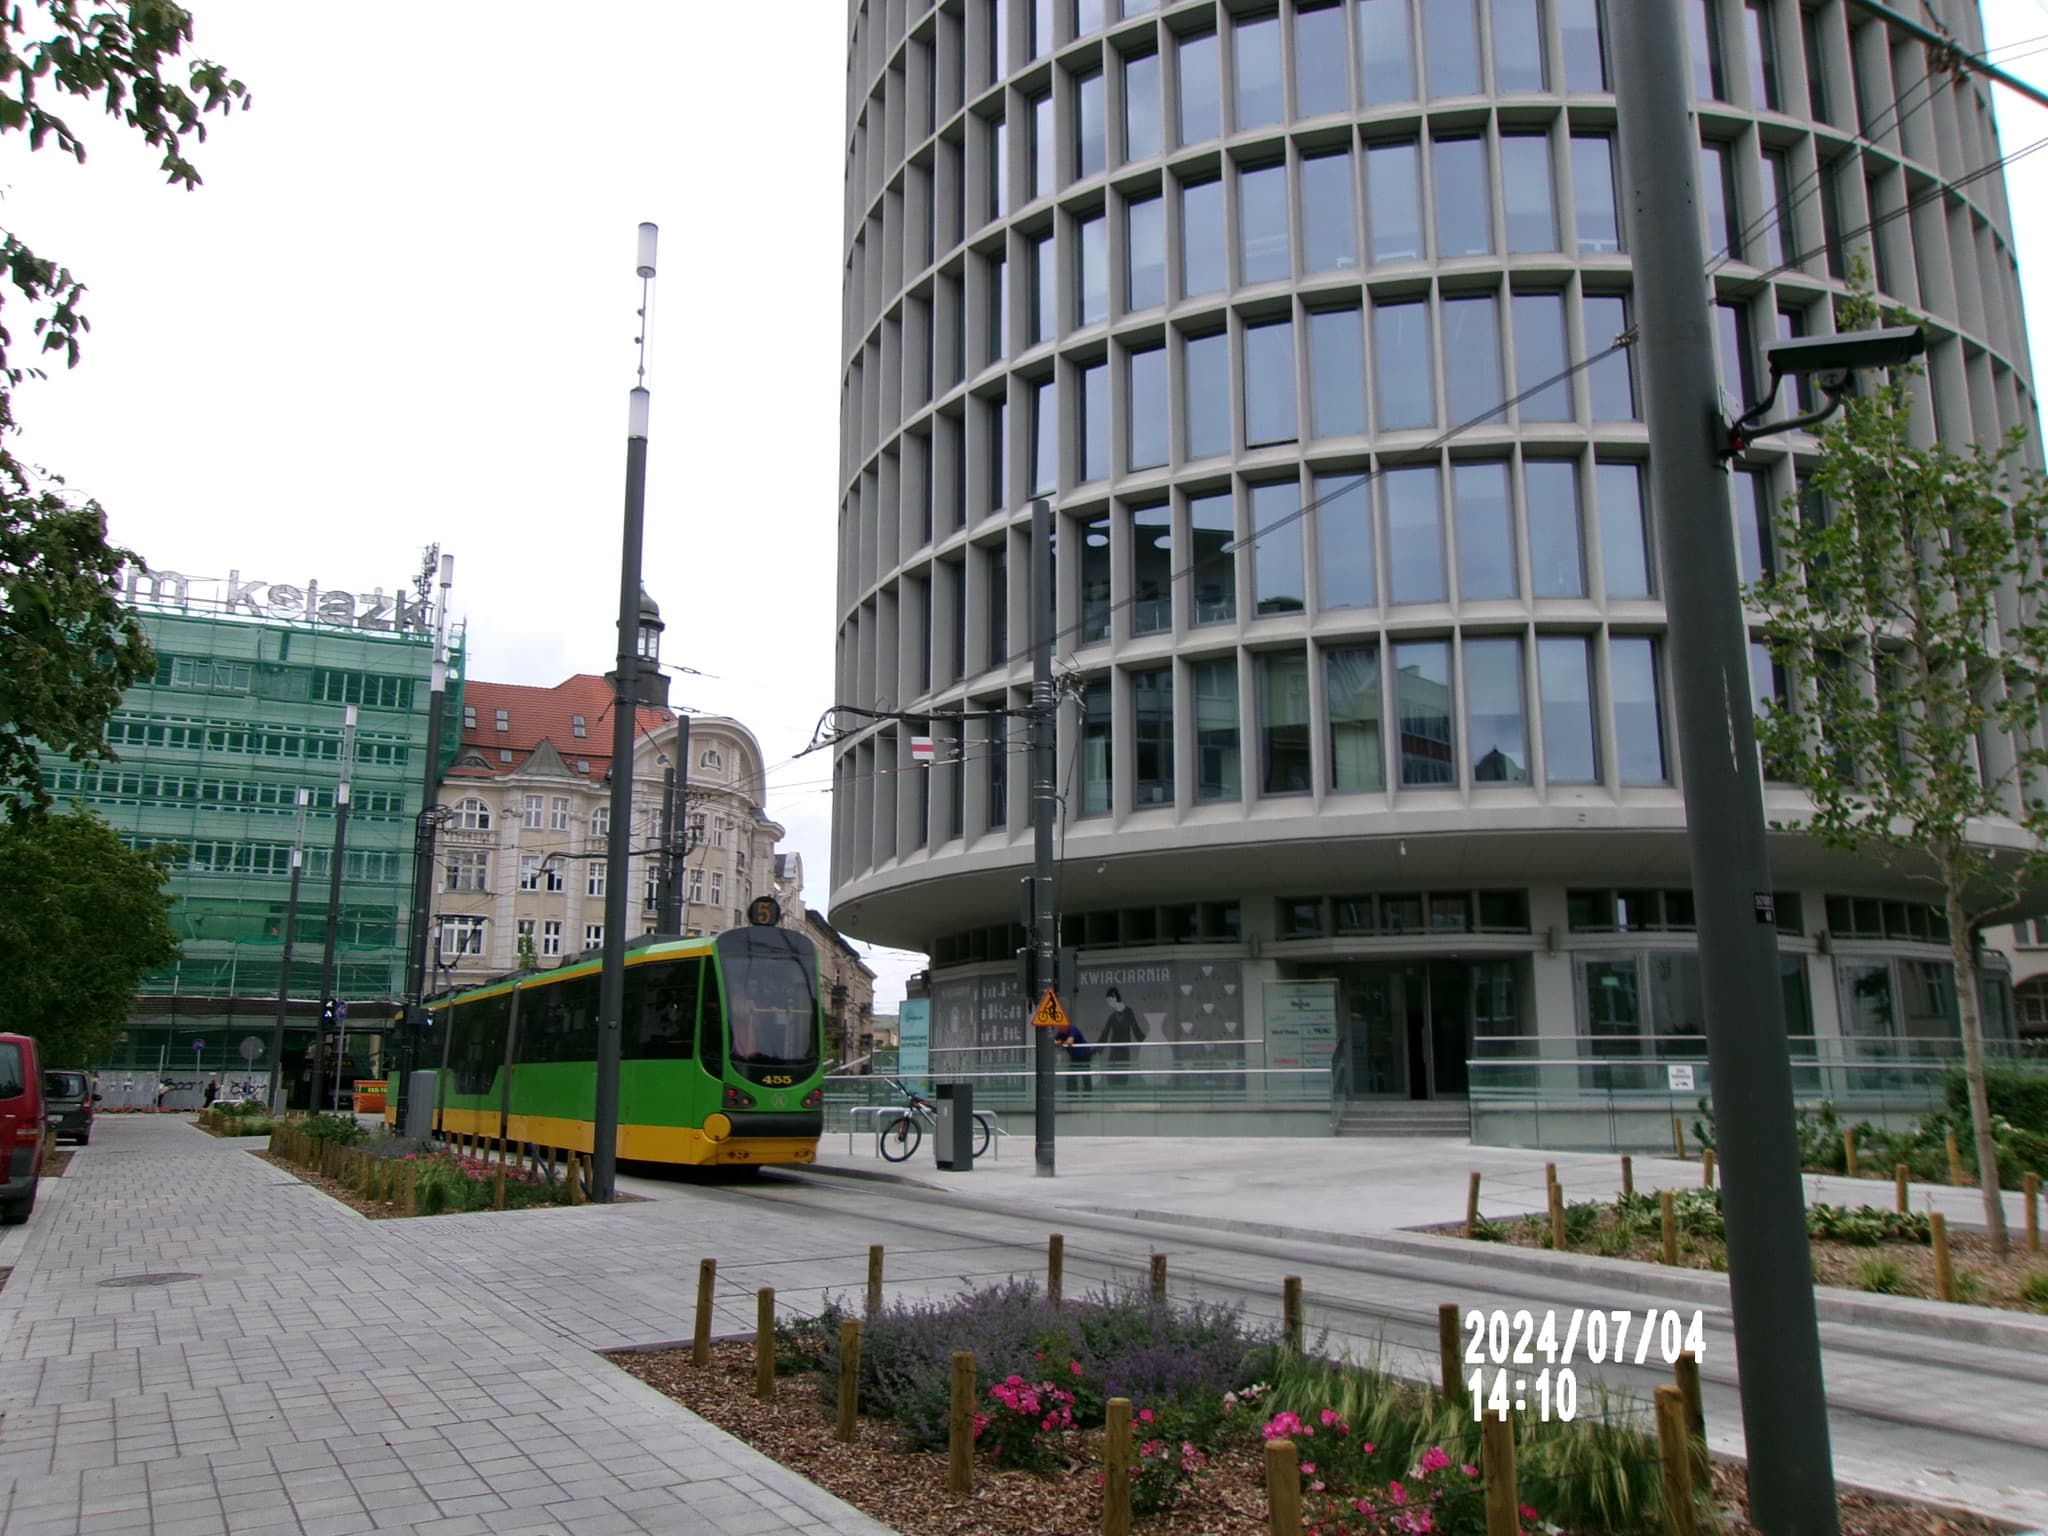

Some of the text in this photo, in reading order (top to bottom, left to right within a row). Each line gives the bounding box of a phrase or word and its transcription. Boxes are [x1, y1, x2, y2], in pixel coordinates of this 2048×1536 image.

[758, 901, 771, 925] 5
[1080, 967, 1170, 986] KWIACIARNIA
[762, 1075, 793, 1085] 455
